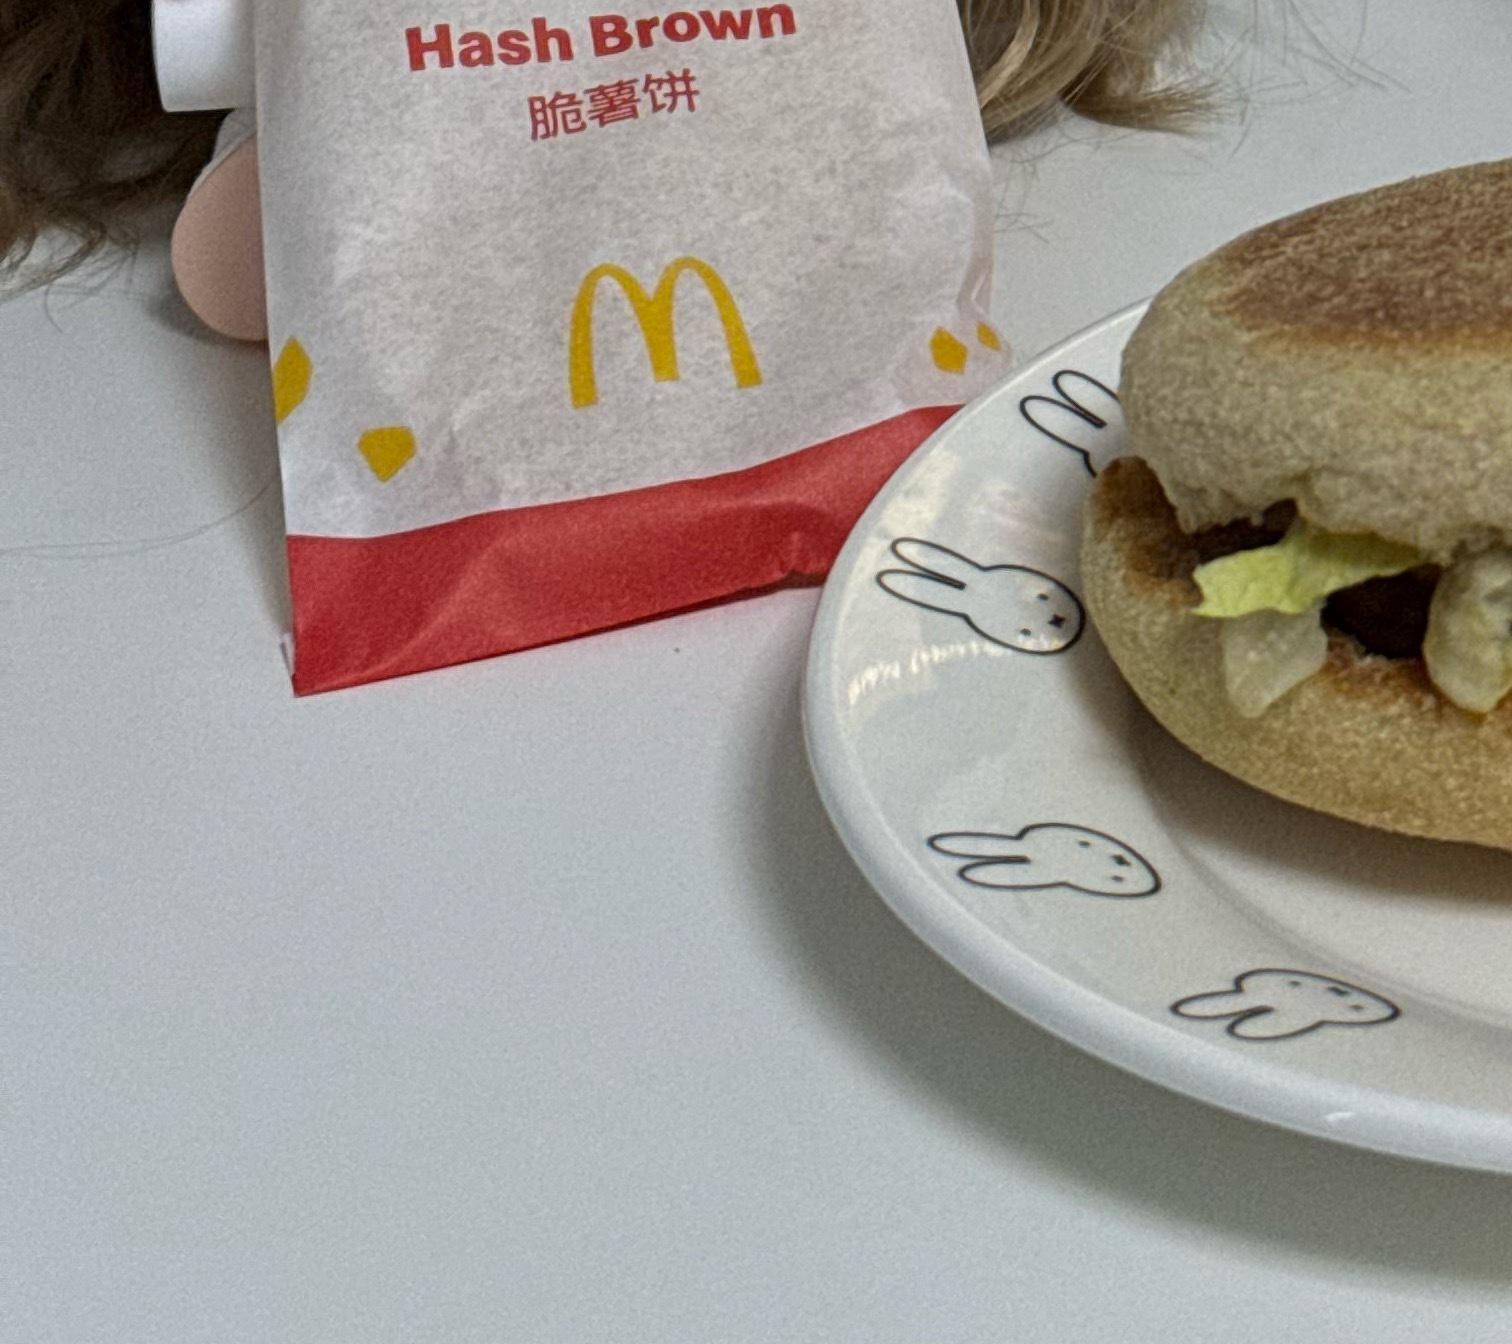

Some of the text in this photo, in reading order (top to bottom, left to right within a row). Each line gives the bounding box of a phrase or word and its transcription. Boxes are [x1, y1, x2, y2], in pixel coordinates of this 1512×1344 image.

[405, 2, 797, 72] Hash Brown
[527, 67, 701, 142] 脆薯饼
